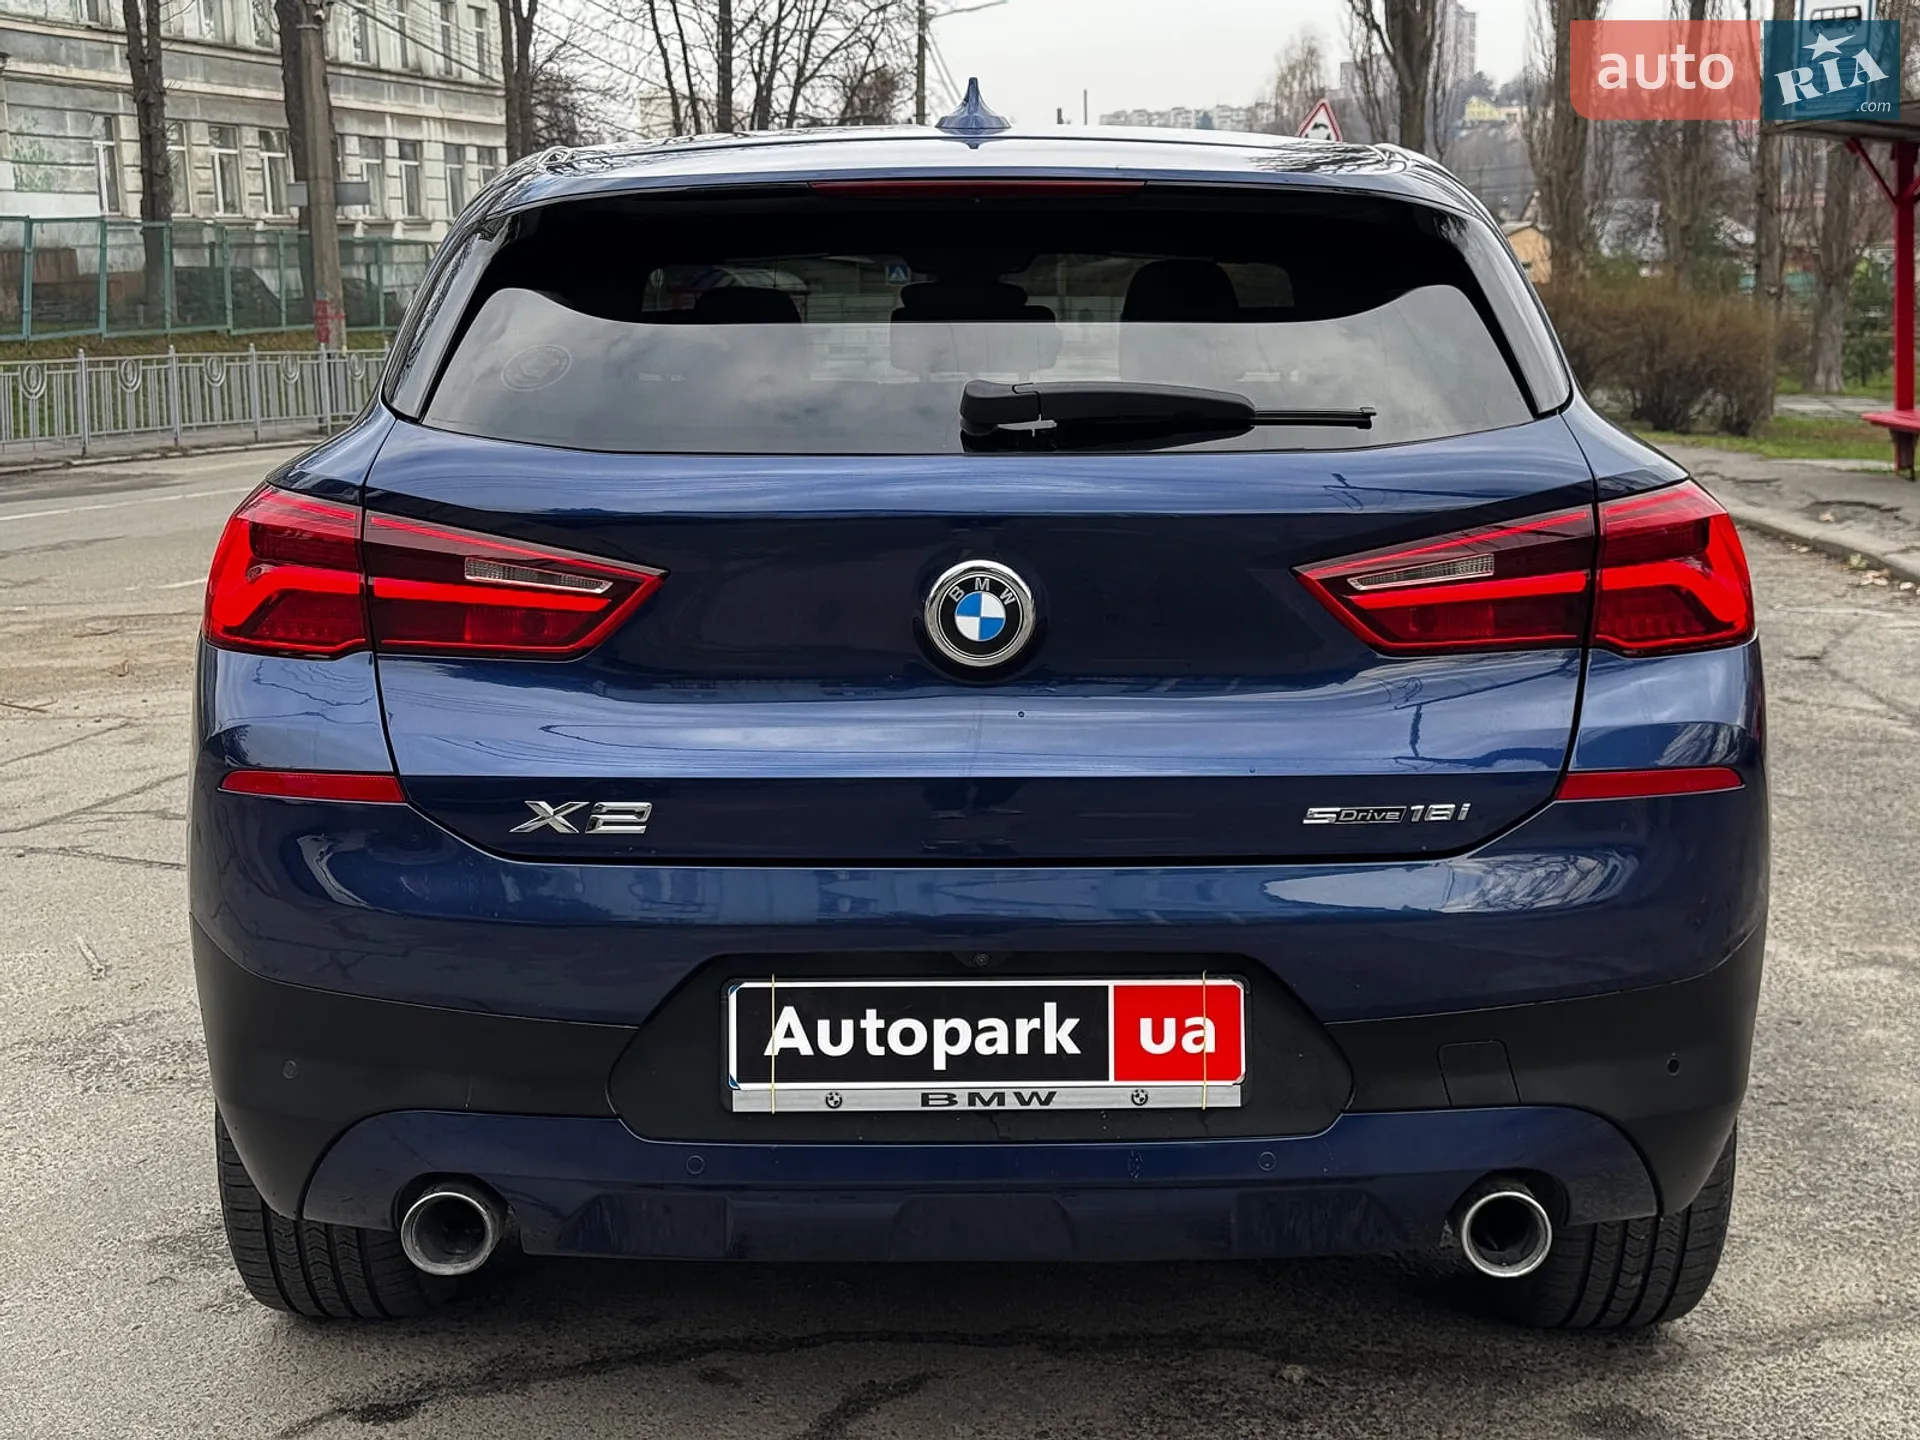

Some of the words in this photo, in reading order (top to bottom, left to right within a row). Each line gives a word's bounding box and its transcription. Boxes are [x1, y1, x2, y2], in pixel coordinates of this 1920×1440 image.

[948, 577, 1016, 606] BMW
[508, 800, 653, 834] X2
[764, 1002, 1082, 1071] Autopark
[1140, 1017, 1216, 1054] ua
[920, 1092, 1057, 1108] BMW
